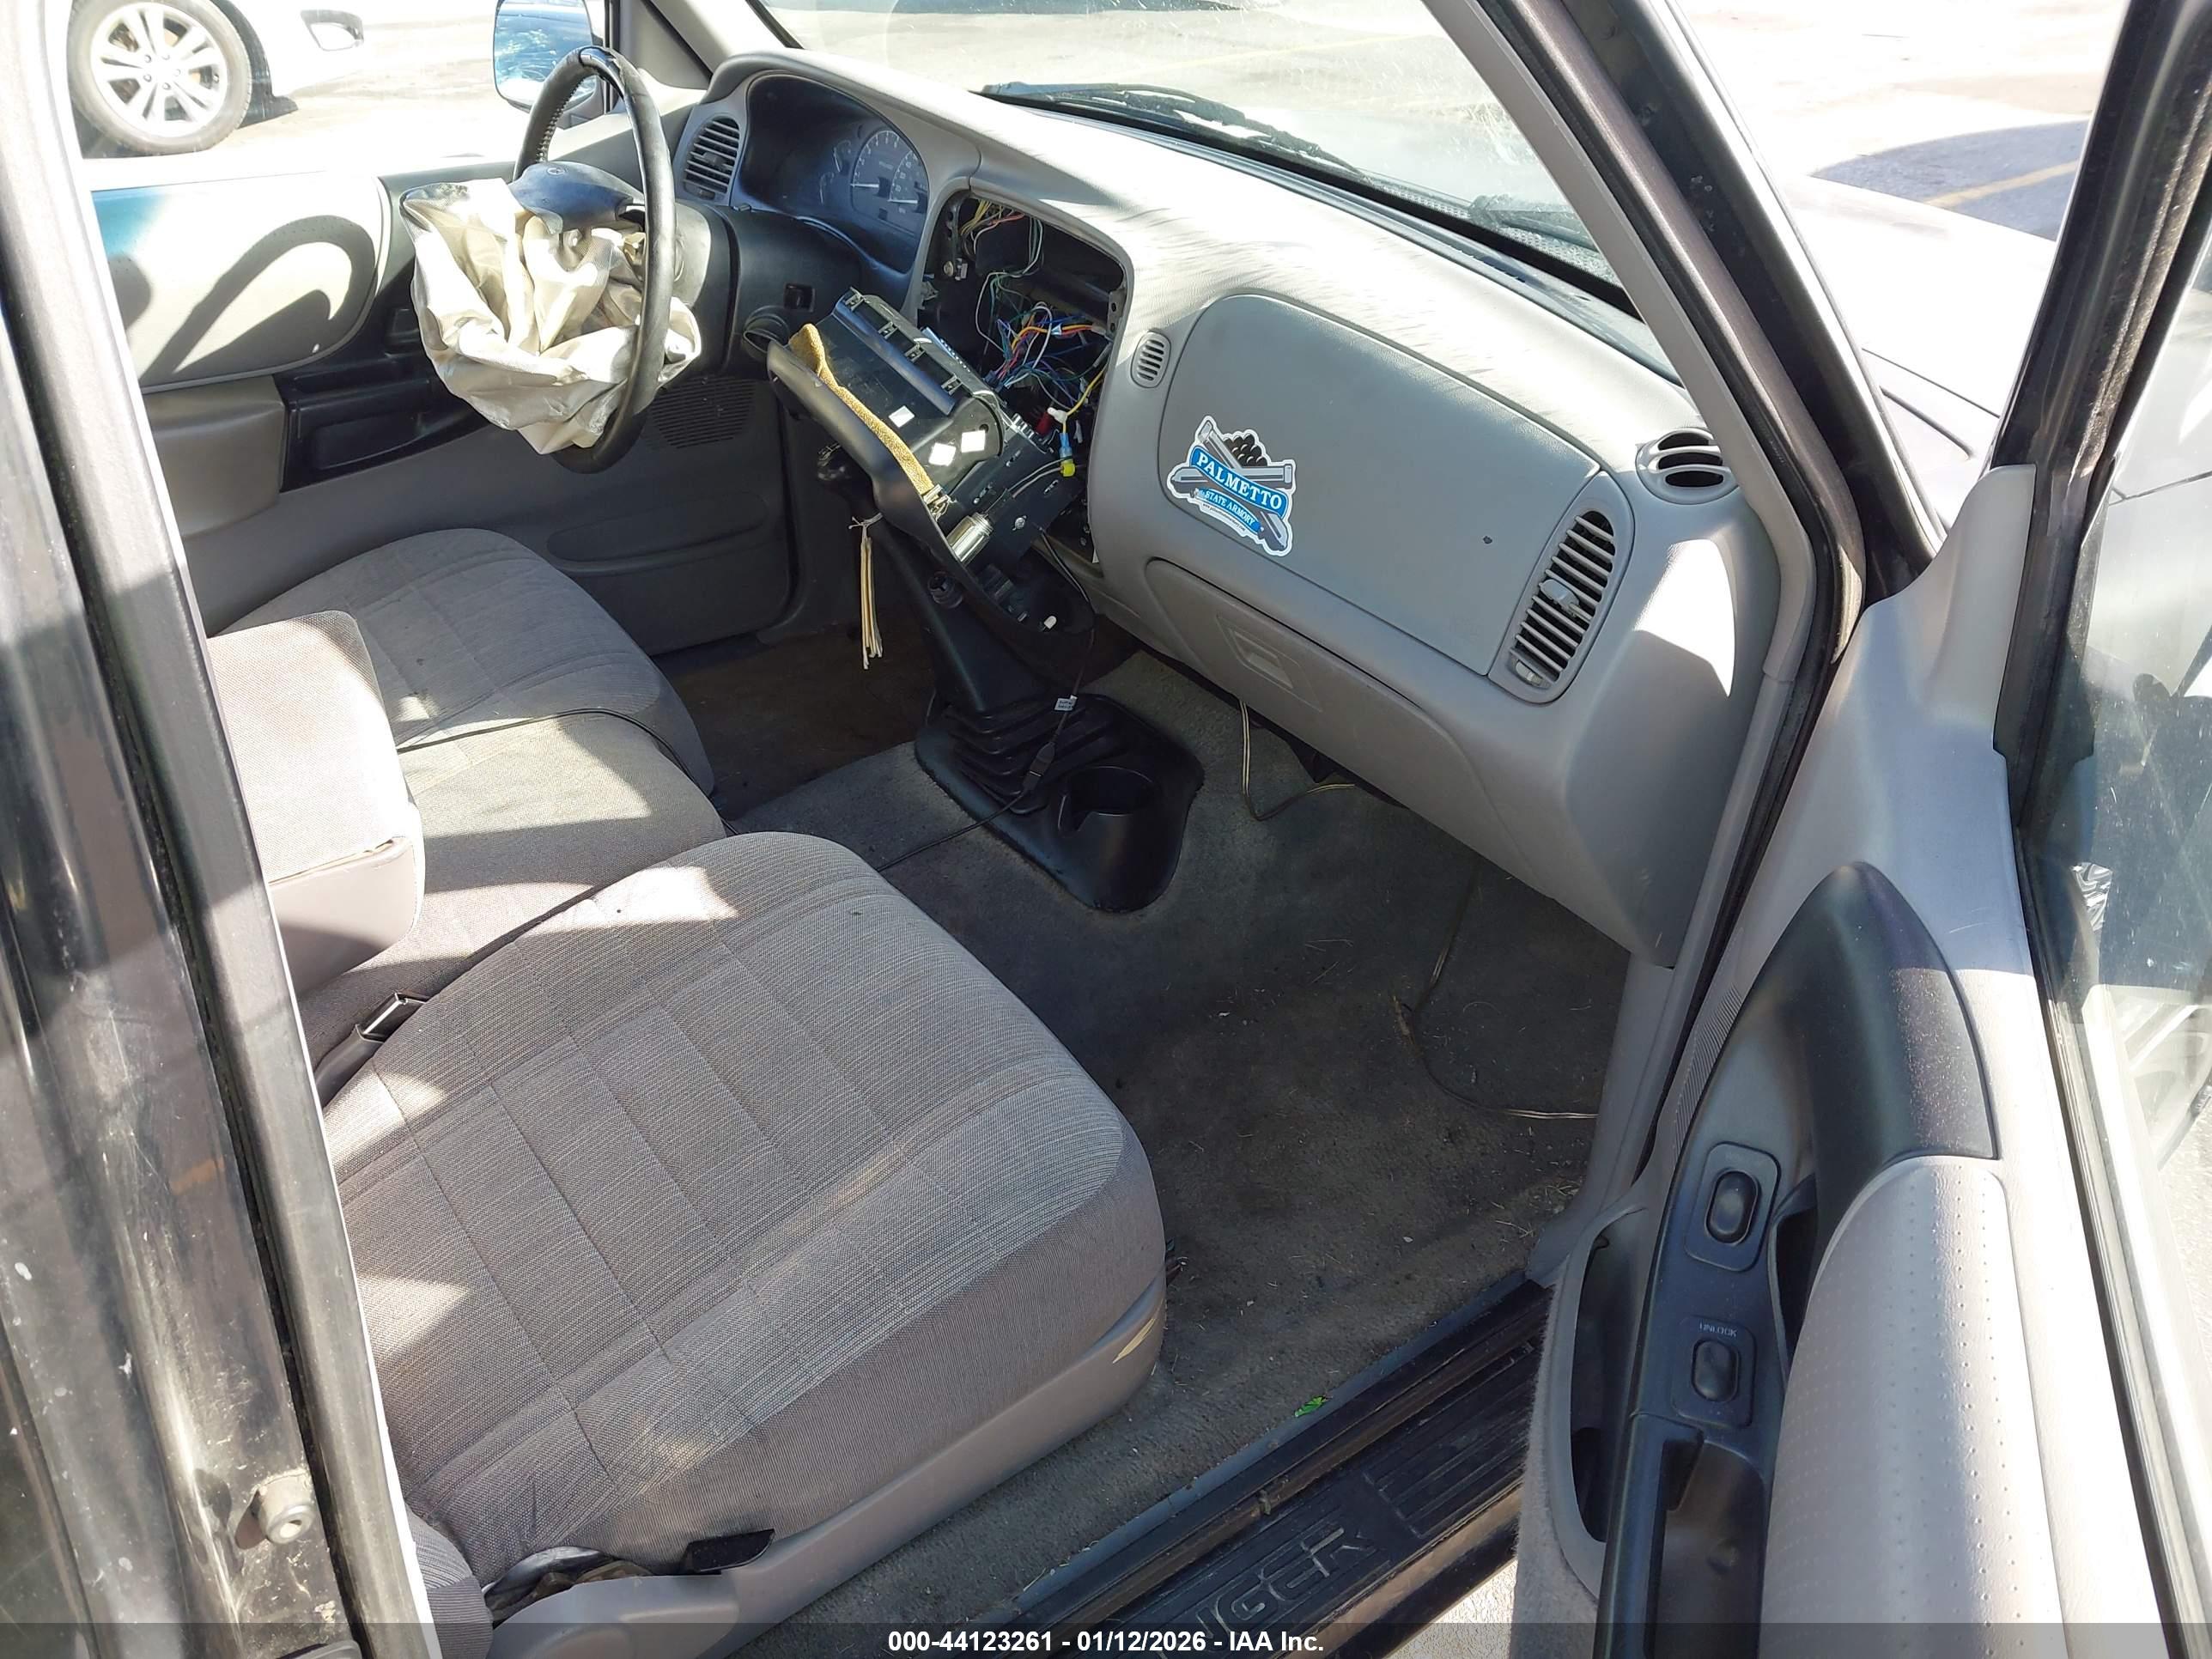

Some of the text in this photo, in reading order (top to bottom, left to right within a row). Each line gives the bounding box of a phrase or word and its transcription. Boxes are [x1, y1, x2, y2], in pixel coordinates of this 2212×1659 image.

[1196, 452, 1282, 510] PALMETTO
[1205, 490, 1227, 507] STATE
[1226, 501, 1255, 526] ARMORY
[1699, 1322, 1737, 1337] UNLOCK
